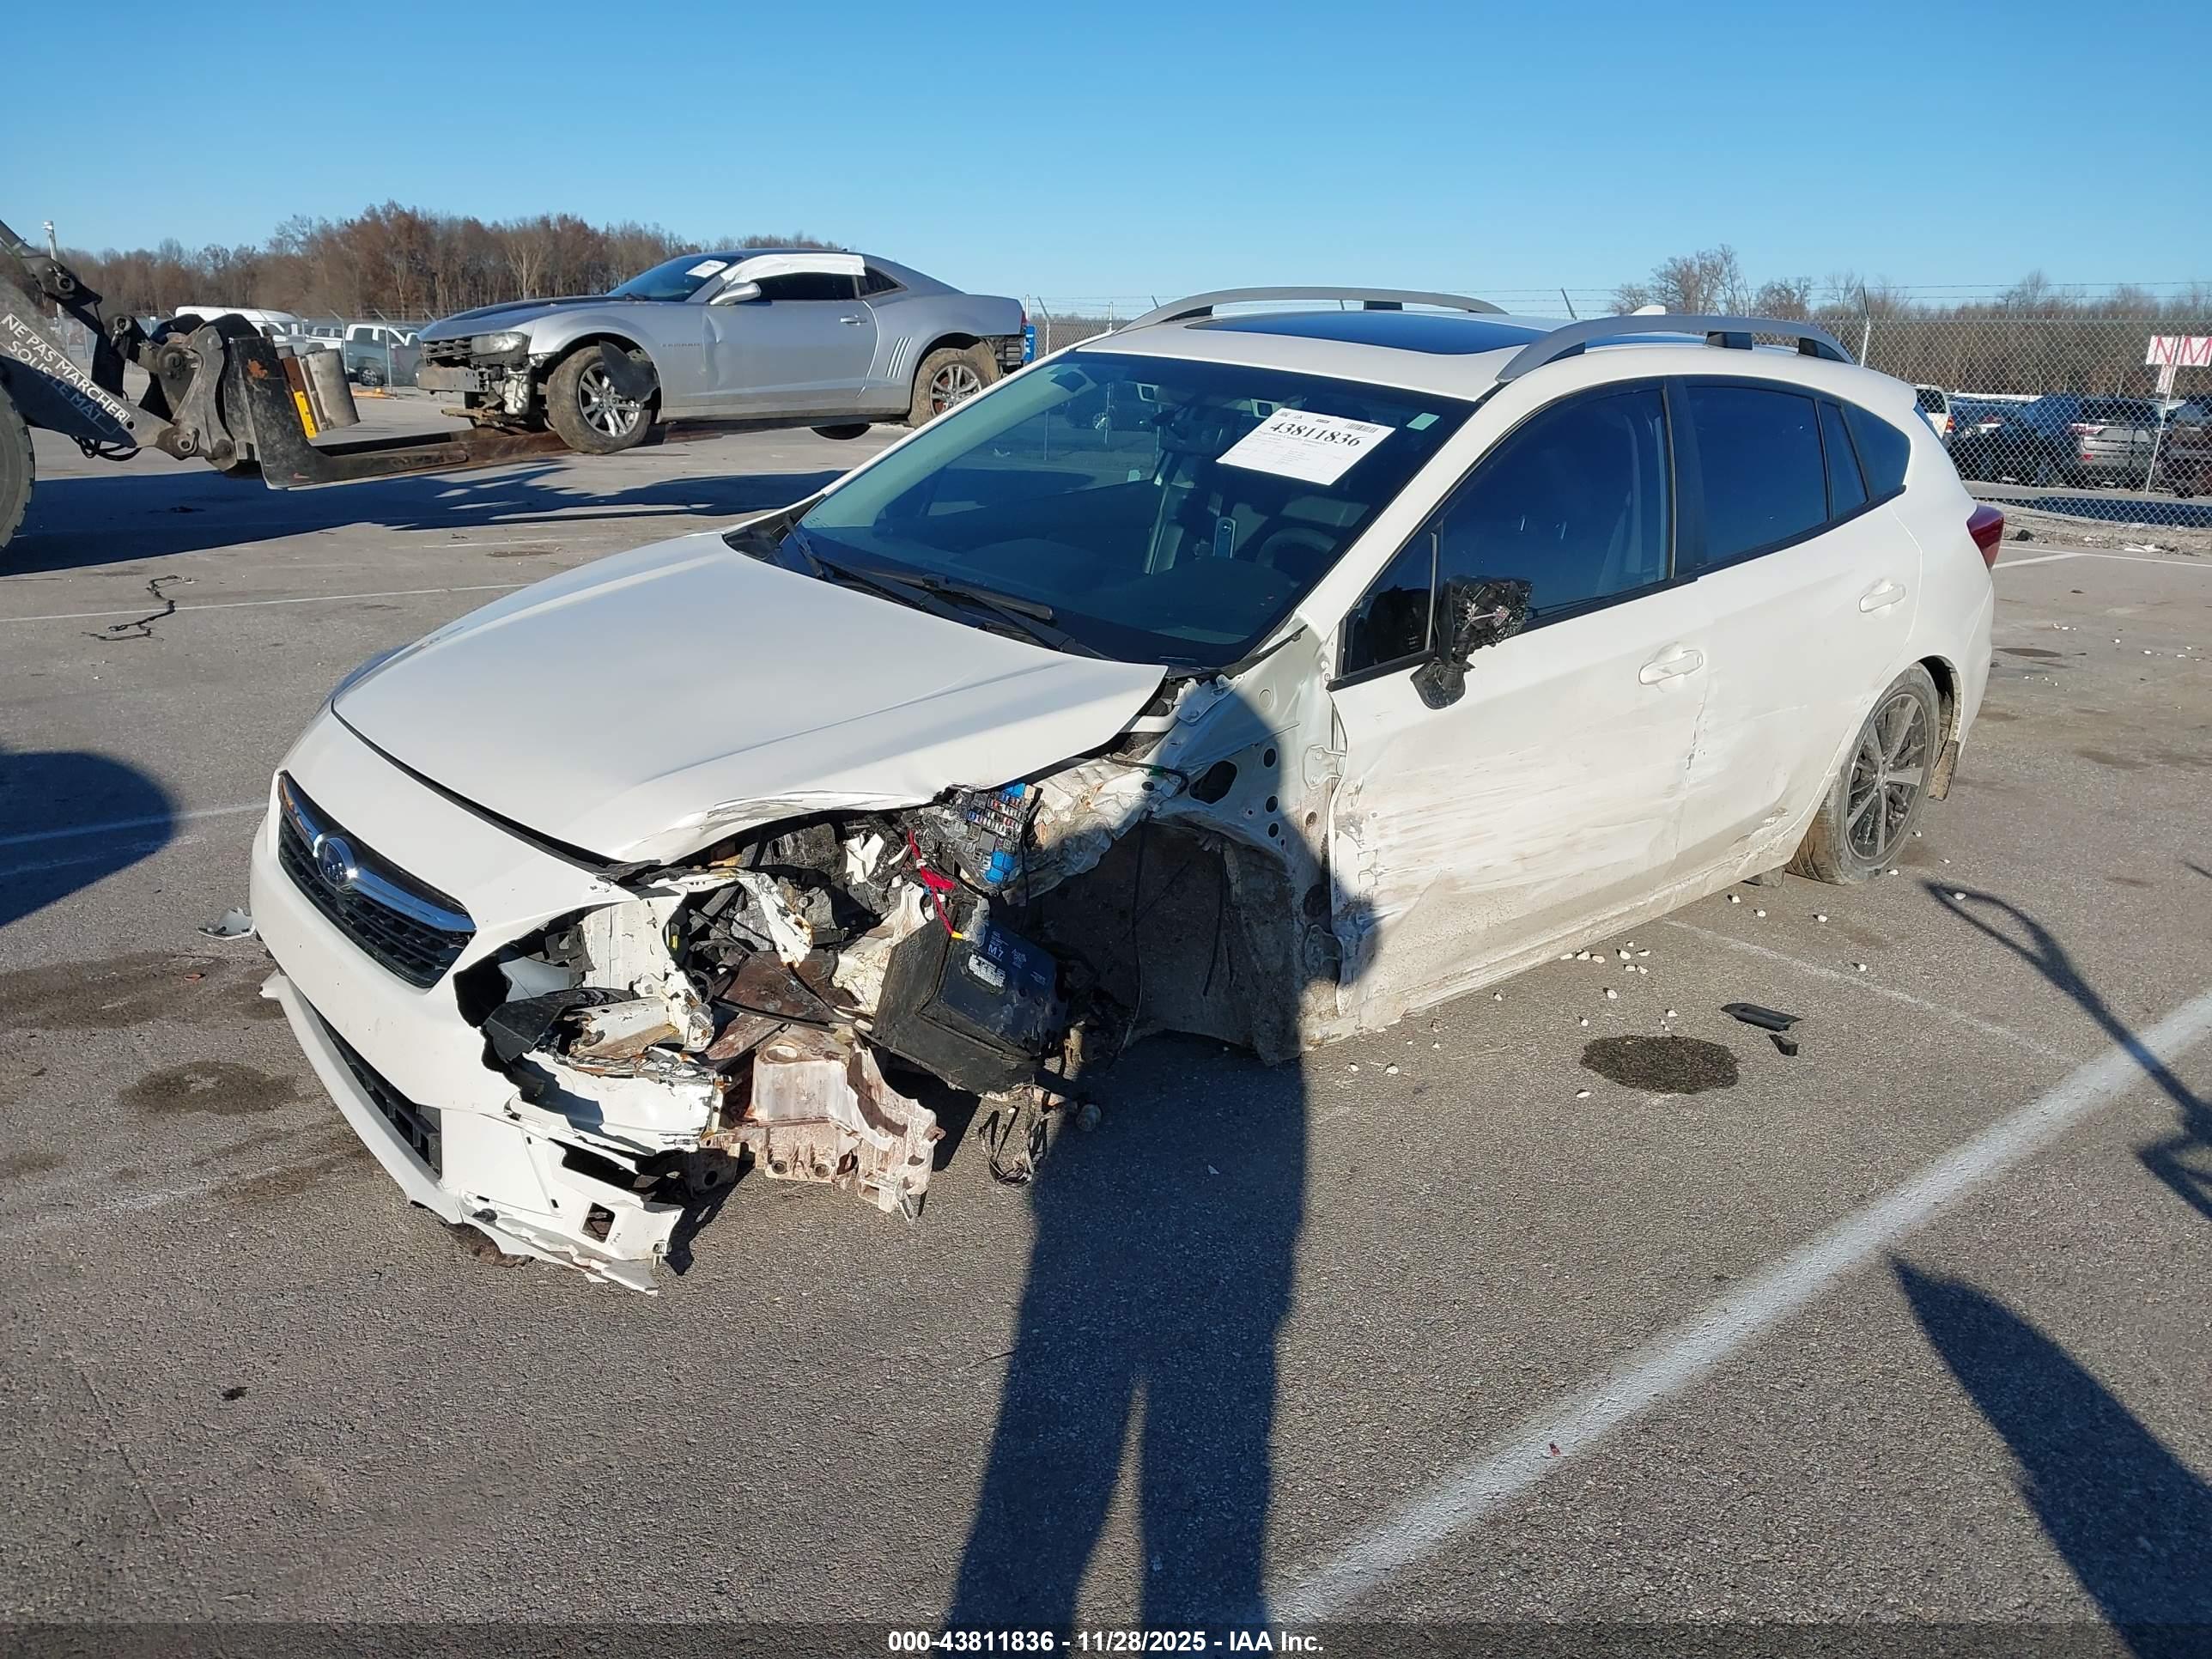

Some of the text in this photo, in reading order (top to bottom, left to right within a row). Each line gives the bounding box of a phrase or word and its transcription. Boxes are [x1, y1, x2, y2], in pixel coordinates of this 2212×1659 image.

[1, 314, 128, 424] NE PAS MARCHER
[9, 340, 53, 376] SOUS
[51, 375, 74, 398] LE
[1269, 421, 1367, 447] 43811836
